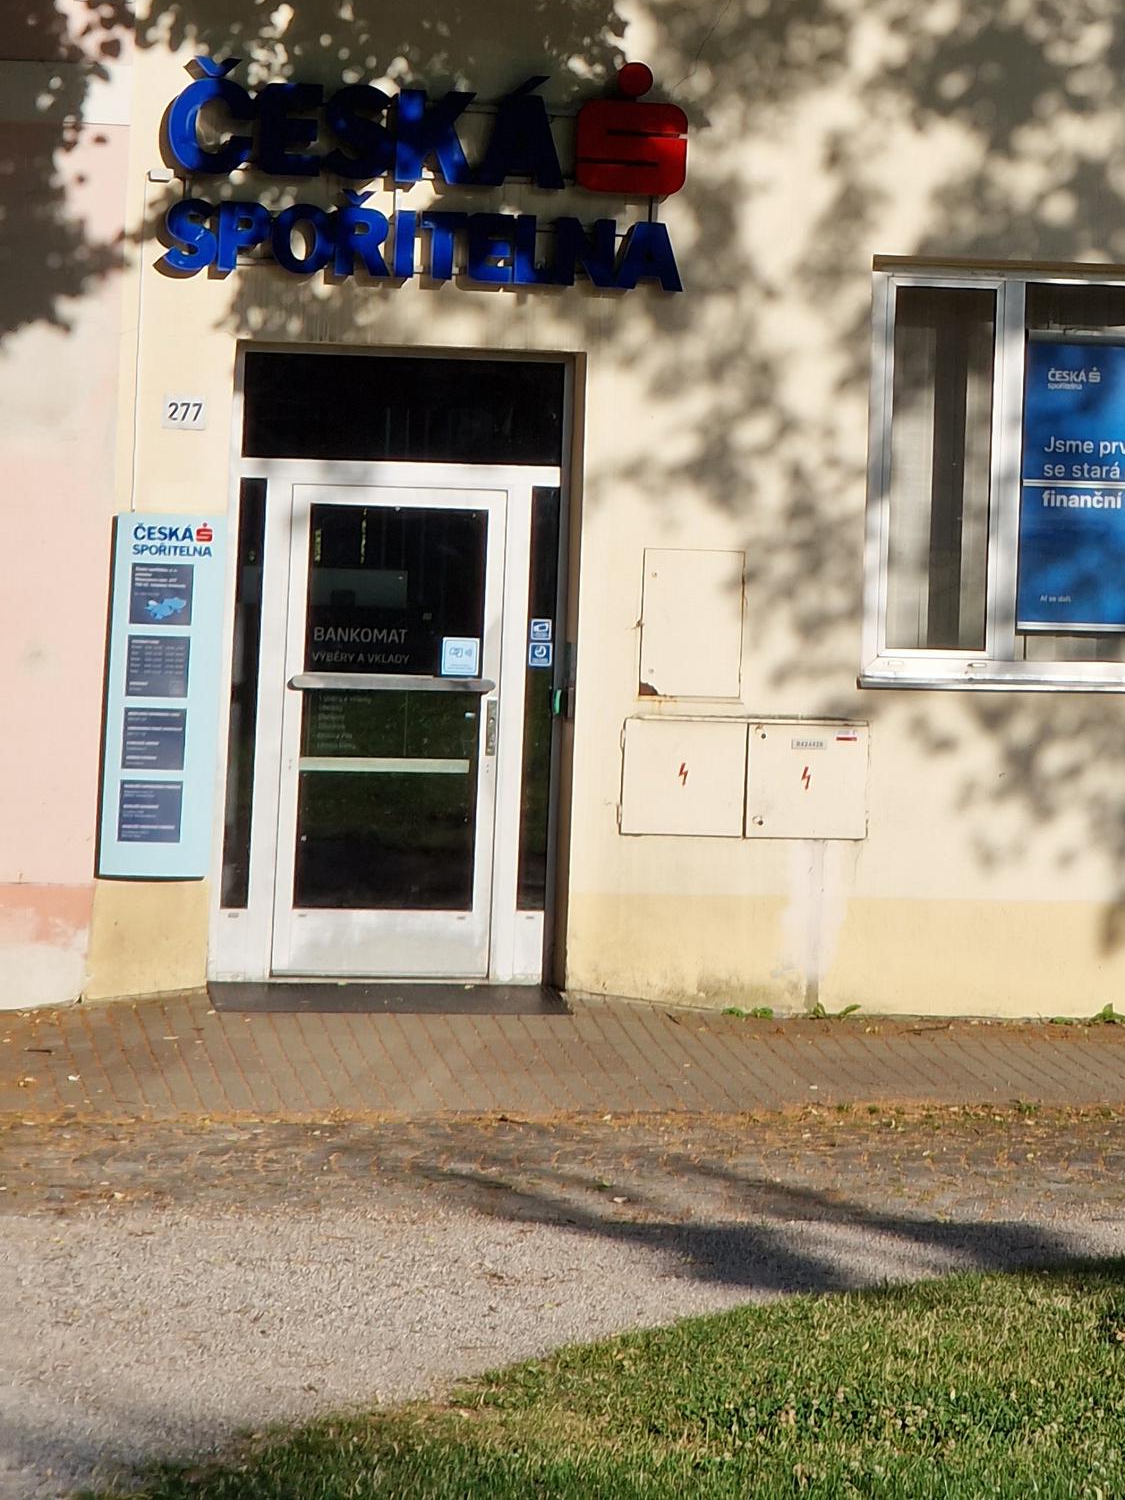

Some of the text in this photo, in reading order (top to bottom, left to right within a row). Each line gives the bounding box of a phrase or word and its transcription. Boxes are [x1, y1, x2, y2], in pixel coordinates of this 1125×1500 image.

[167, 55, 565, 190] ČESKÁ
[162, 188, 683, 293] SPOŘITELNA
[1047, 367, 1087, 383] ČESKÁ
[168, 402, 203, 422] 277
[1044, 436, 1094, 455] Jsme
[1043, 463, 1066, 478] se
[1071, 461, 1121, 479] stará
[1042, 490, 1123, 509] finanční
[133, 522, 194, 542] ČESKÁ
[132, 542, 212, 558] SPOŘITELNA
[313, 626, 409, 644] BANKOMAT
[357, 652, 366, 663] A
[367, 653, 410, 666] VKLADY
